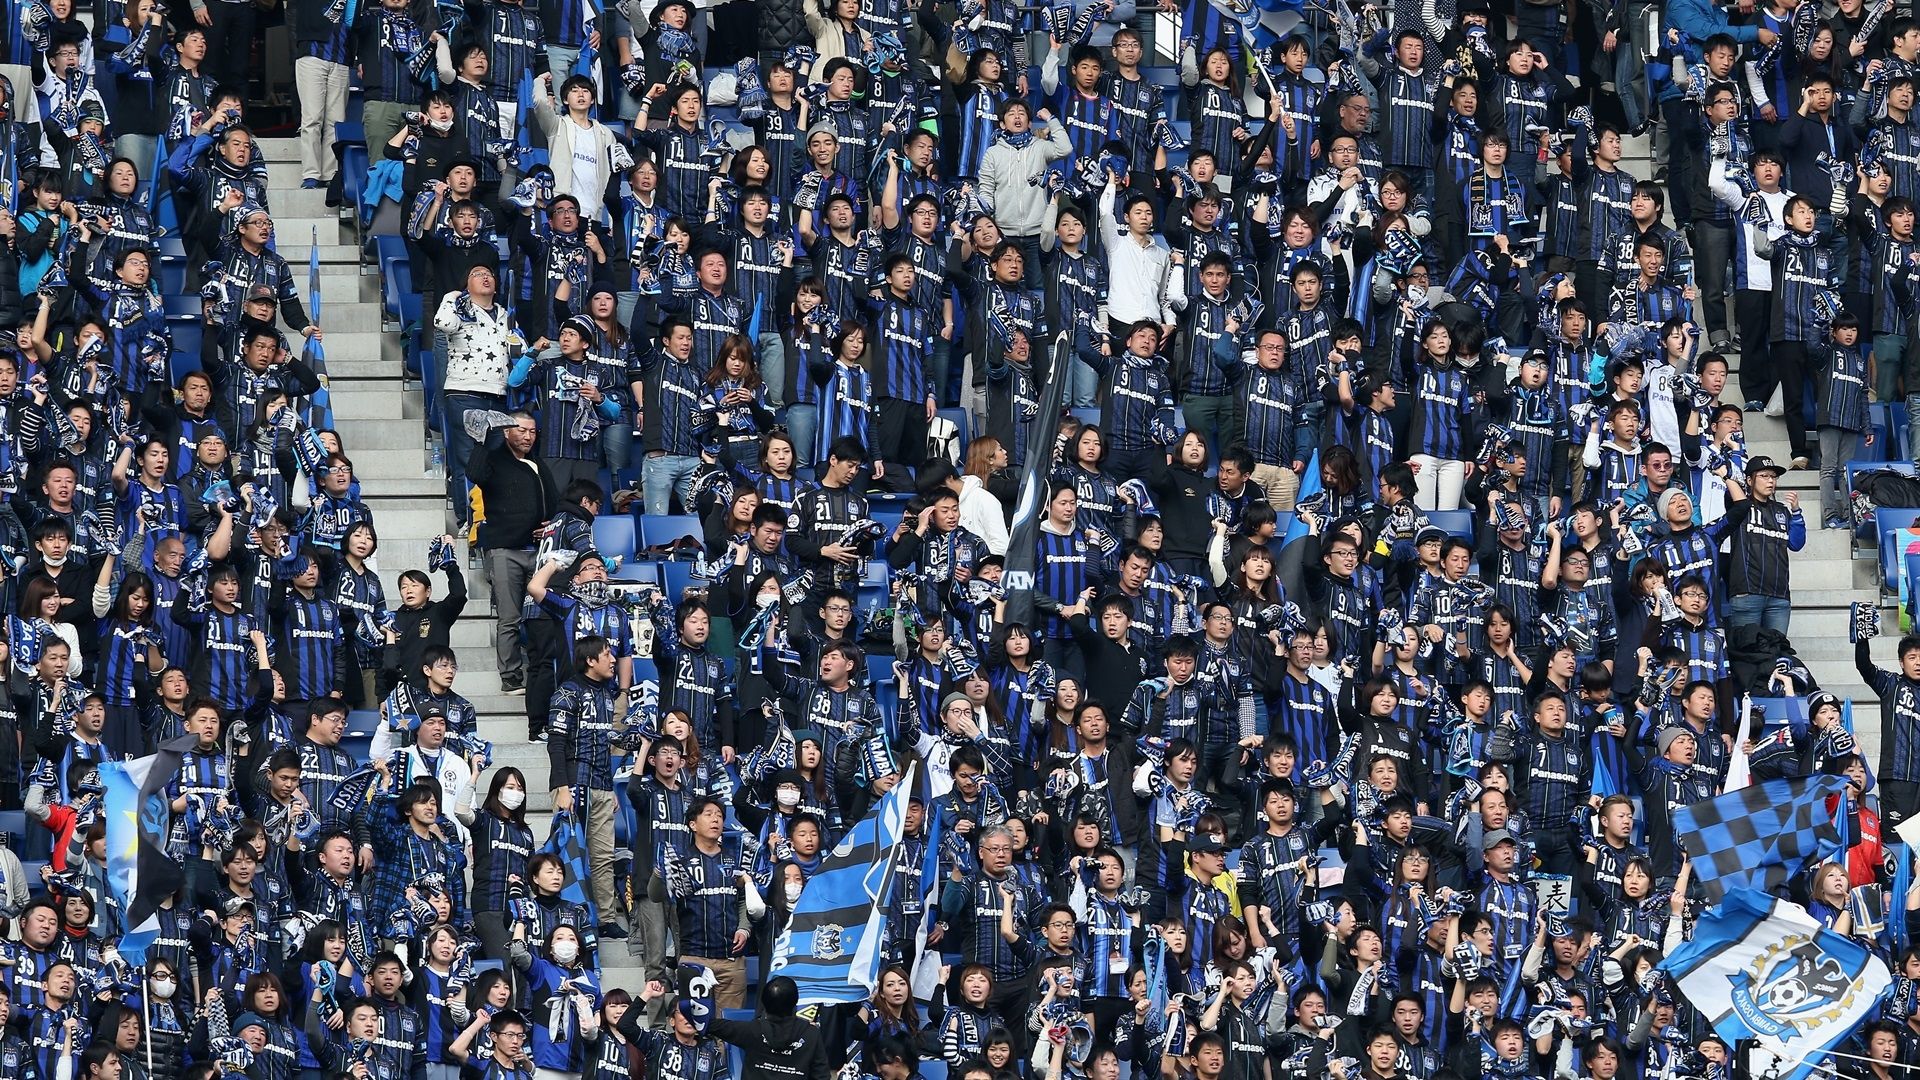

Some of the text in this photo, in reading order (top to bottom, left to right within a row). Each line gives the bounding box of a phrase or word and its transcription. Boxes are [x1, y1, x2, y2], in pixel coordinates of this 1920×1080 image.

[500, 17, 507, 32] 7
[873, 83, 882, 96] 8
[1398, 81, 1404, 96] 7
[1511, 83, 1519, 96] 8
[978, 94, 989, 109] 13
[1208, 92, 1219, 107] 10
[767, 114, 783, 130] 39
[1067, 116, 1107, 135] Panasonic
[670, 141, 684, 158] 14
[741, 245, 752, 261] 10
[914, 246, 922, 262] 8
[1193, 240, 1208, 258] 39
[1618, 243, 1634, 259] 38
[1890, 248, 1902, 266] 10
[737, 261, 781, 274] Panasonic
[1787, 254, 1802, 272] 24
[699, 306, 707, 320] 9
[891, 312, 898, 329] 9
[1200, 312, 1209, 328] 9
[1838, 358, 1844, 369] 8
[1121, 371, 1129, 385] 9
[1257, 377, 1267, 393] 8
[1019, 379, 1026, 395] 8
[1516, 405, 1523, 420] 7
[1373, 418, 1380, 434] 9
[1509, 422, 1555, 436] Panasonic
[254, 450, 271, 466] 14
[1610, 462, 1618, 480] 7
[1077, 482, 1093, 499] 40
[336, 508, 349, 524] 10
[817, 503, 831, 520] 21
[1750, 507, 1762, 525] 11
[930, 548, 937, 565] 8
[1665, 550, 1680, 566] 11
[259, 560, 270, 576] 10
[752, 557, 761, 575] 8
[1503, 559, 1511, 575] 8
[341, 578, 355, 597] 22
[1337, 593, 1346, 612] 9
[1435, 597, 1450, 613] 10
[578, 613, 592, 630] 36
[979, 615, 992, 633] 41
[207, 623, 221, 639] 21
[679, 661, 694, 679] 22
[1486, 665, 1492, 683] 9
[582, 701, 597, 718] 24
[813, 695, 831, 714] 38
[301, 753, 319, 768] 22
[1538, 750, 1546, 767] 7
[659, 802, 666, 820] 9
[1265, 848, 1274, 865] 4
[1602, 856, 1616, 872] 10
[326, 896, 335, 912] 9
[983, 888, 989, 904] 7
[1544, 882, 1567, 911] 表
[1088, 908, 1107, 925] 20
[18, 958, 34, 975] 39
[604, 1043, 617, 1060] 10
[663, 1051, 681, 1070] 38
